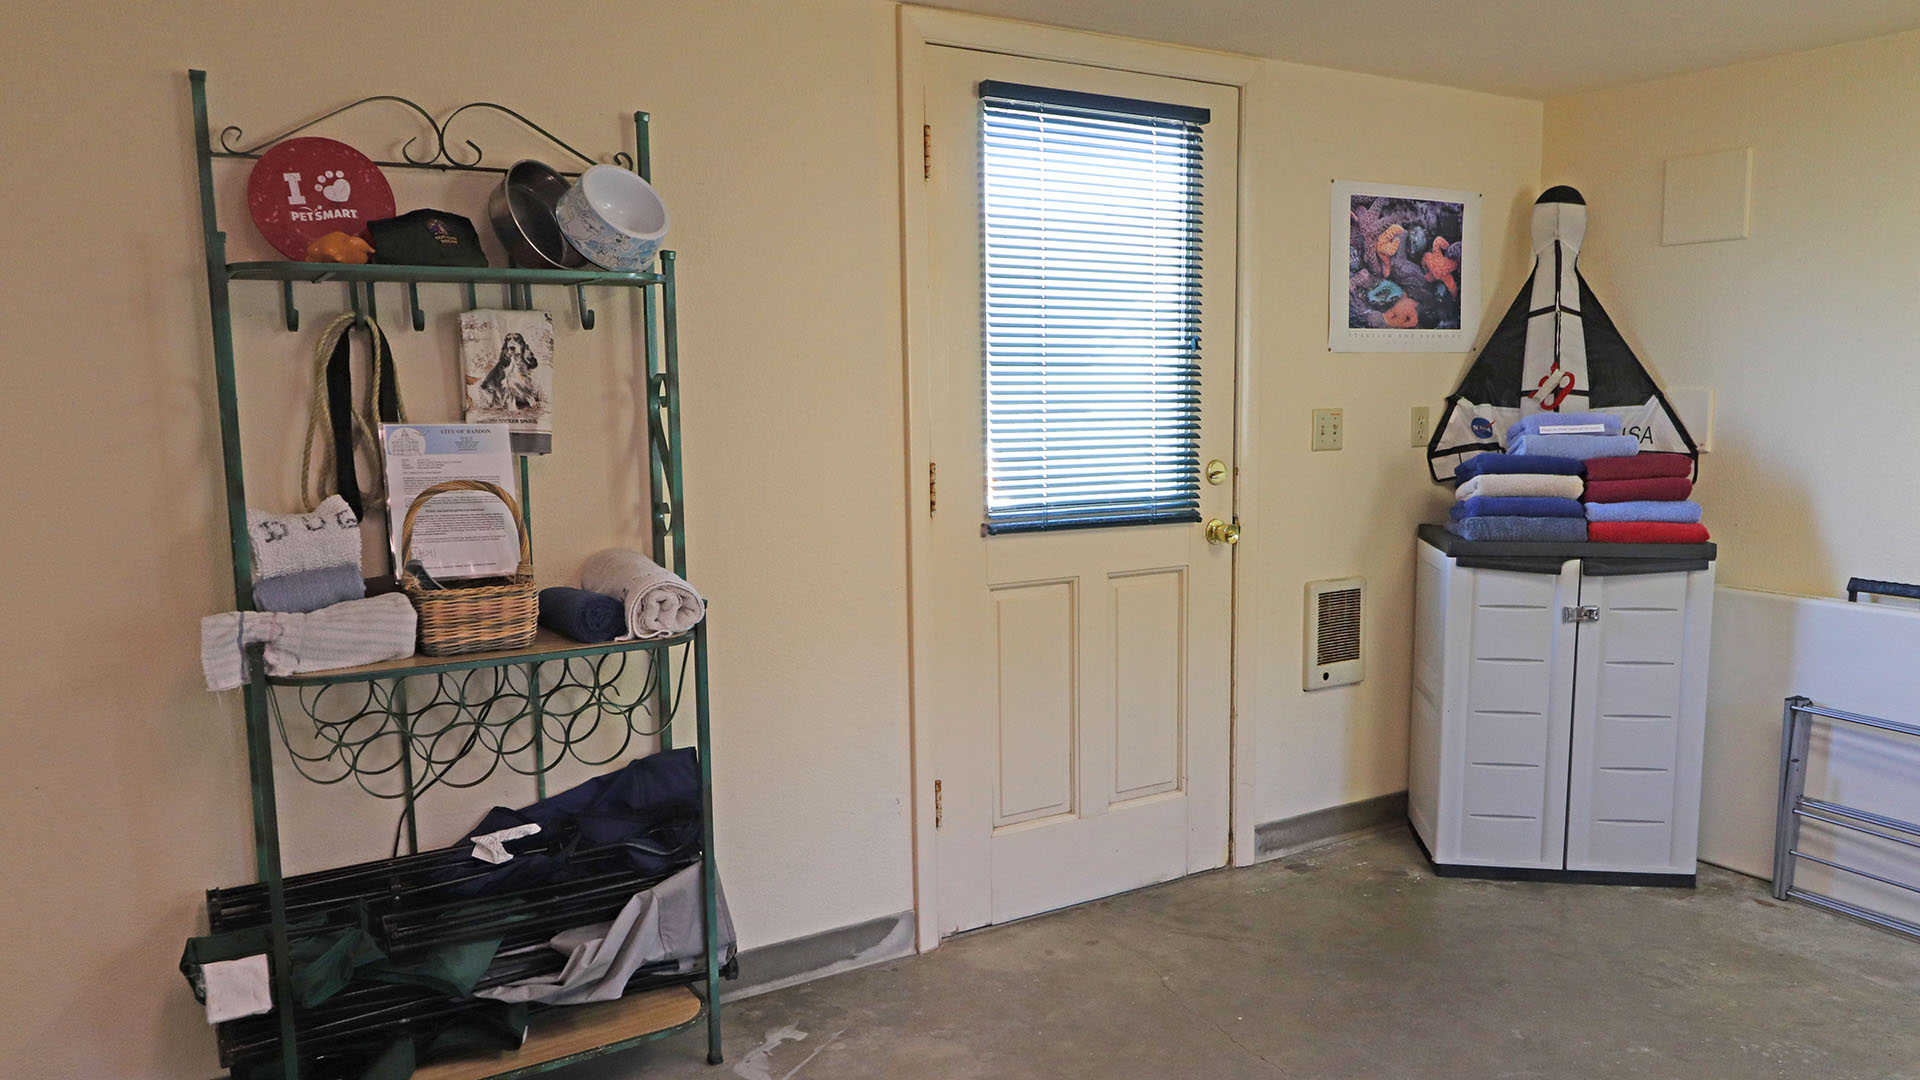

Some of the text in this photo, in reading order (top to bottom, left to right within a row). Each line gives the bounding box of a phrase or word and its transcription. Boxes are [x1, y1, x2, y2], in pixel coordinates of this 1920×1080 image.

[283, 172, 306, 205] I
[290, 208, 359, 222] PETSMART
[1472, 424, 1492, 433] NASA
[1622, 426, 1654, 445] SA
